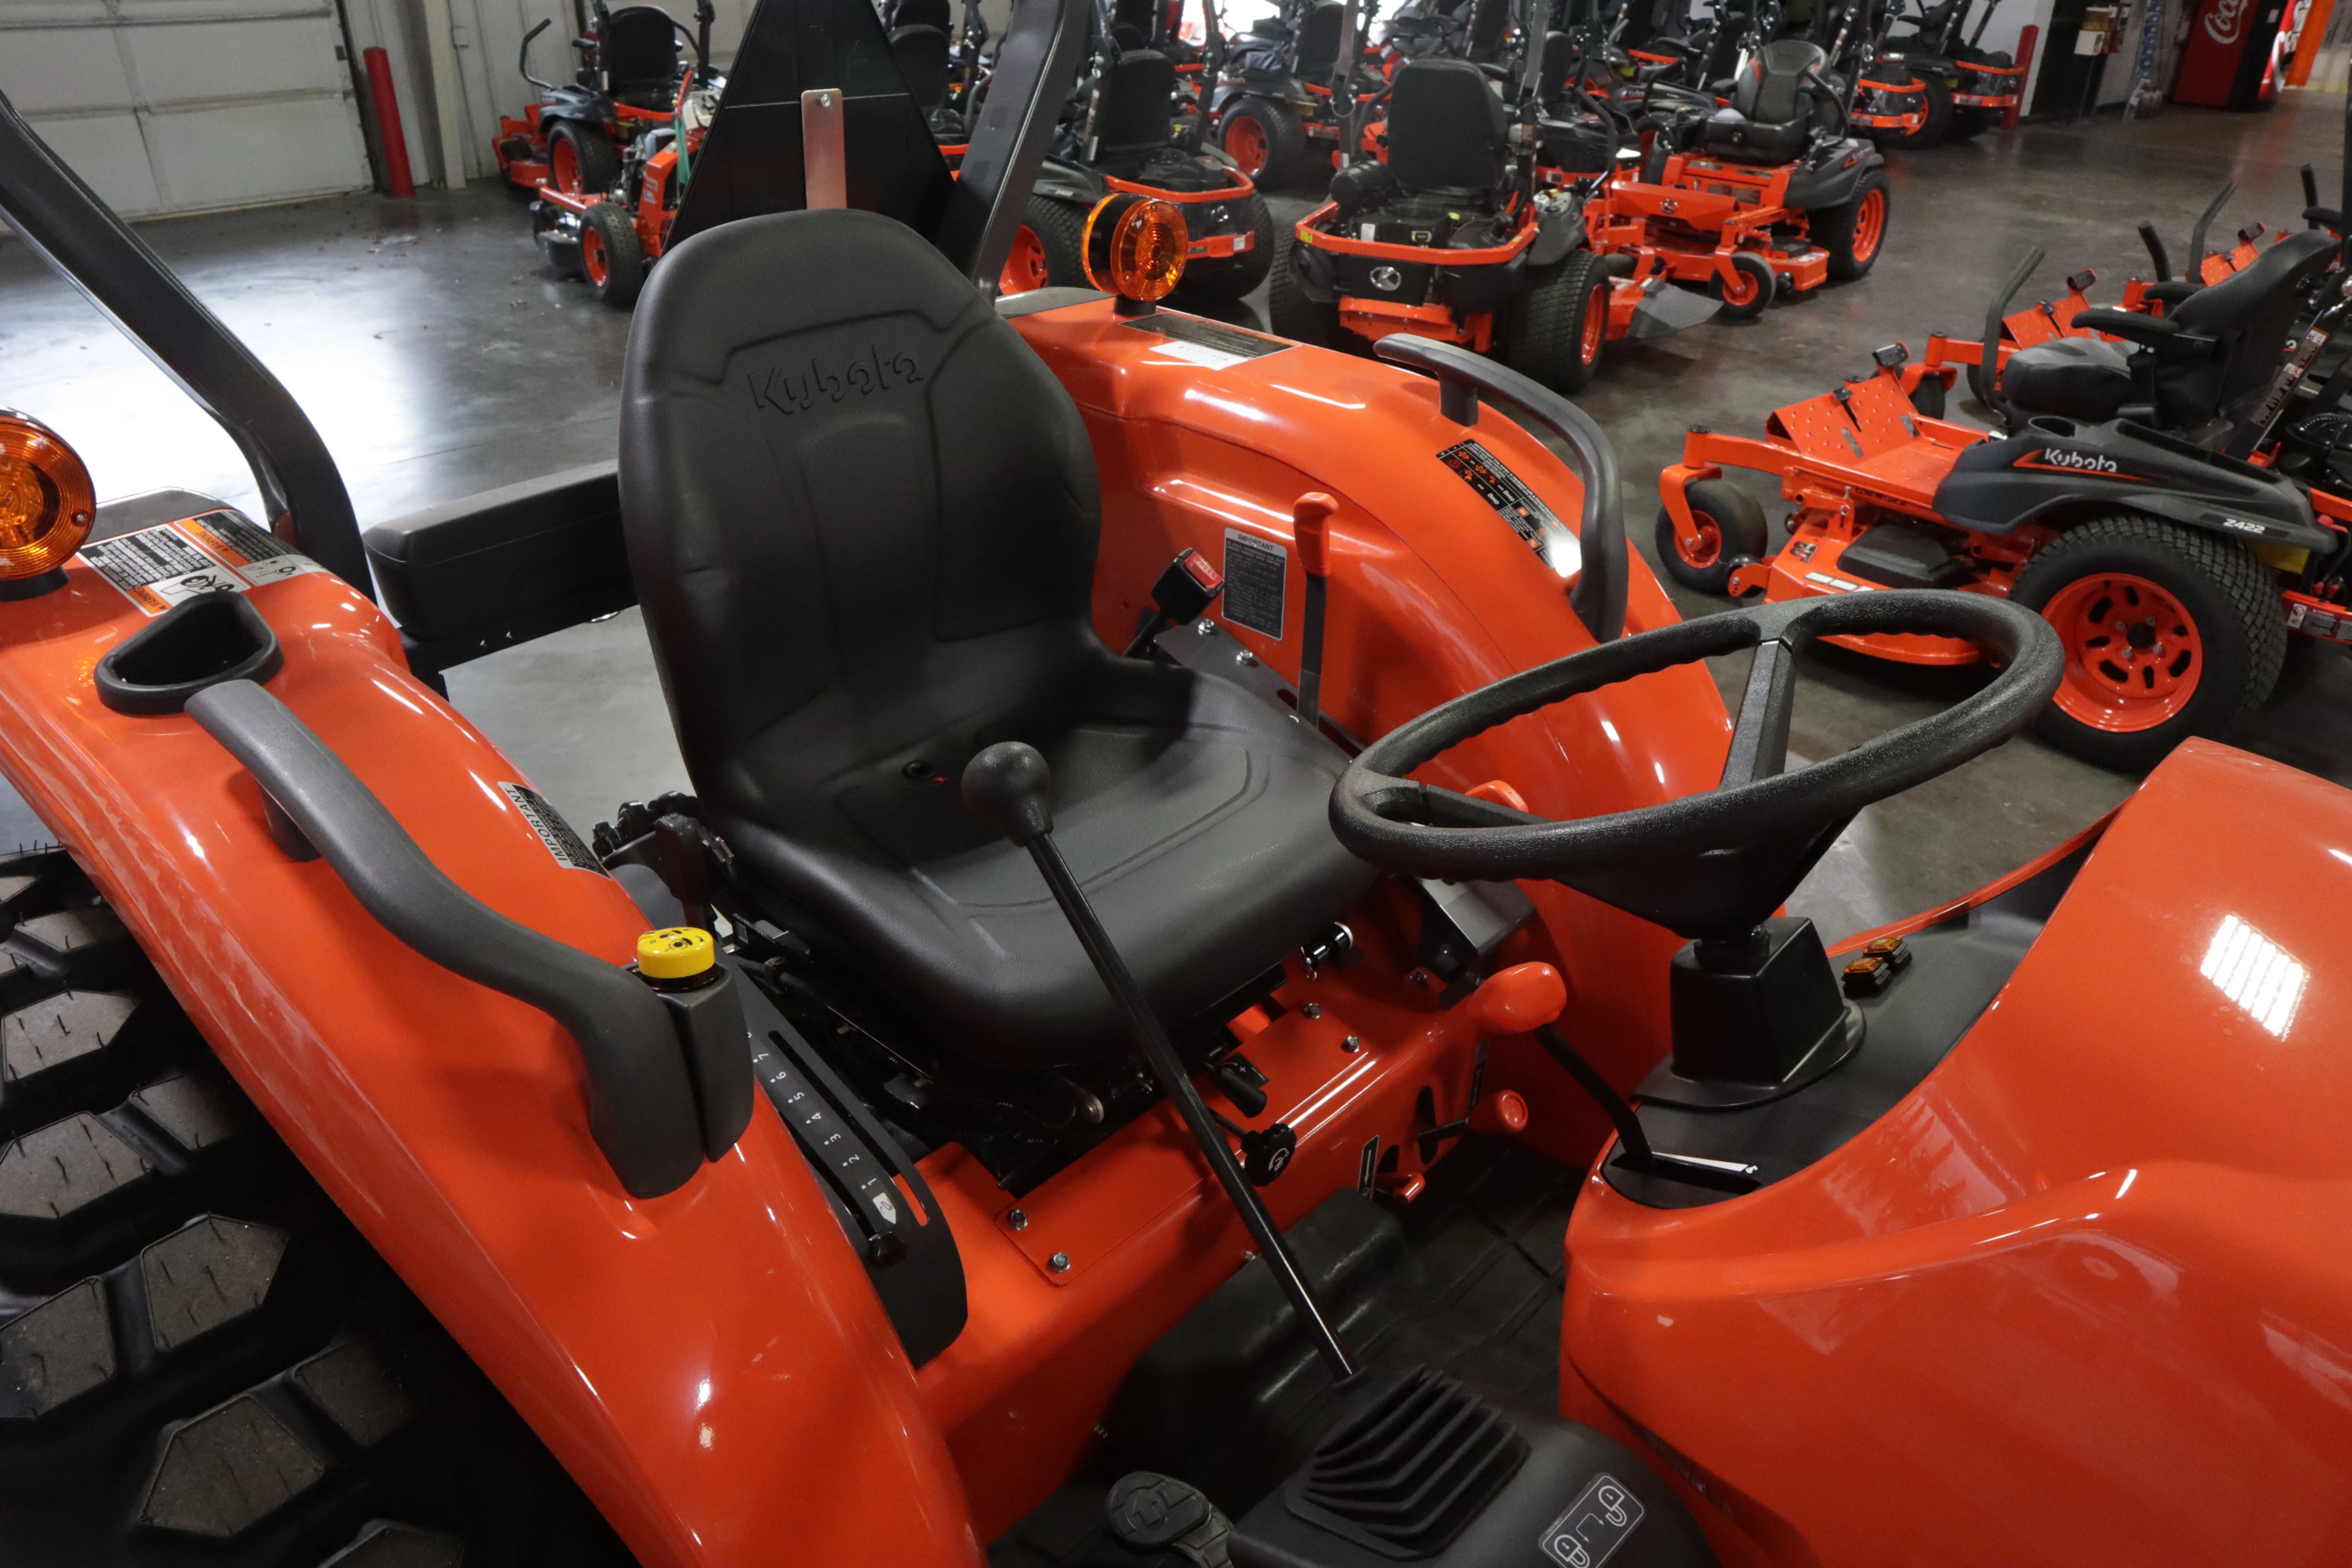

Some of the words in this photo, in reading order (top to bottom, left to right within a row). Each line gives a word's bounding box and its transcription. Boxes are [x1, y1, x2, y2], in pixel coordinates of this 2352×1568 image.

[748, 344, 924, 415] Kubota
[2044, 448, 2117, 473] Kubota
[1487, 493, 1501, 505] Beep
[1503, 490, 1515, 502] Beep
[2223, 518, 2266, 534] Z422
[1238, 534, 1274, 551] IMPORTANT
[1196, 558, 1216, 578] PRESS
[505, 788, 568, 861] IMPORTANT
[537, 813, 556, 835] DAMAGE
[555, 837, 570, 854] AVOID
[565, 844, 583, 865] CLUTCH
[569, 856, 577, 864] TO
[776, 1071, 787, 1080] 6
[793, 1092, 805, 1100] 5
[811, 1112, 822, 1120] 4
[830, 1133, 841, 1142] 3
[849, 1154, 860, 1164] 2
[867, 1178, 877, 1186] 1
